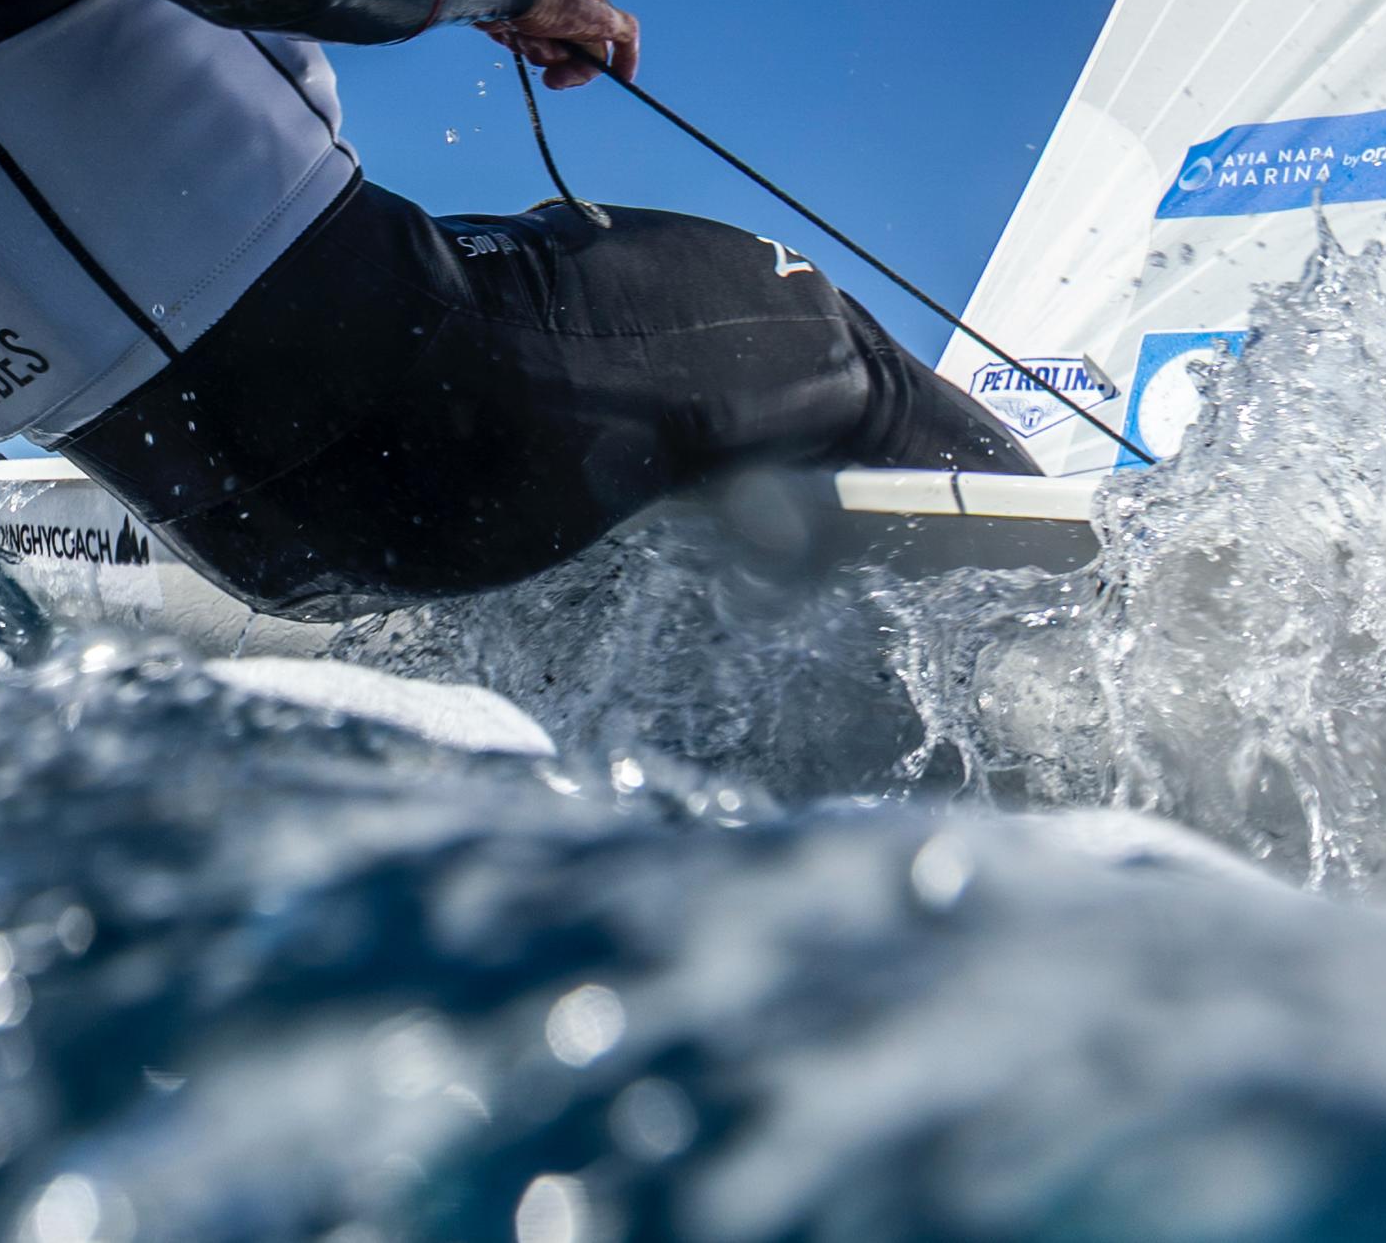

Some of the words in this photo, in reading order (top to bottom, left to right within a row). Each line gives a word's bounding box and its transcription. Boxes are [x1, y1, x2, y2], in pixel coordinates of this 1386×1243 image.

[1221, 150, 1269, 168] AYIA
[1278, 145, 1335, 164] NAPA
[1218, 162, 1331, 188] MARINA
[978, 366, 1098, 393] PETROLIN
